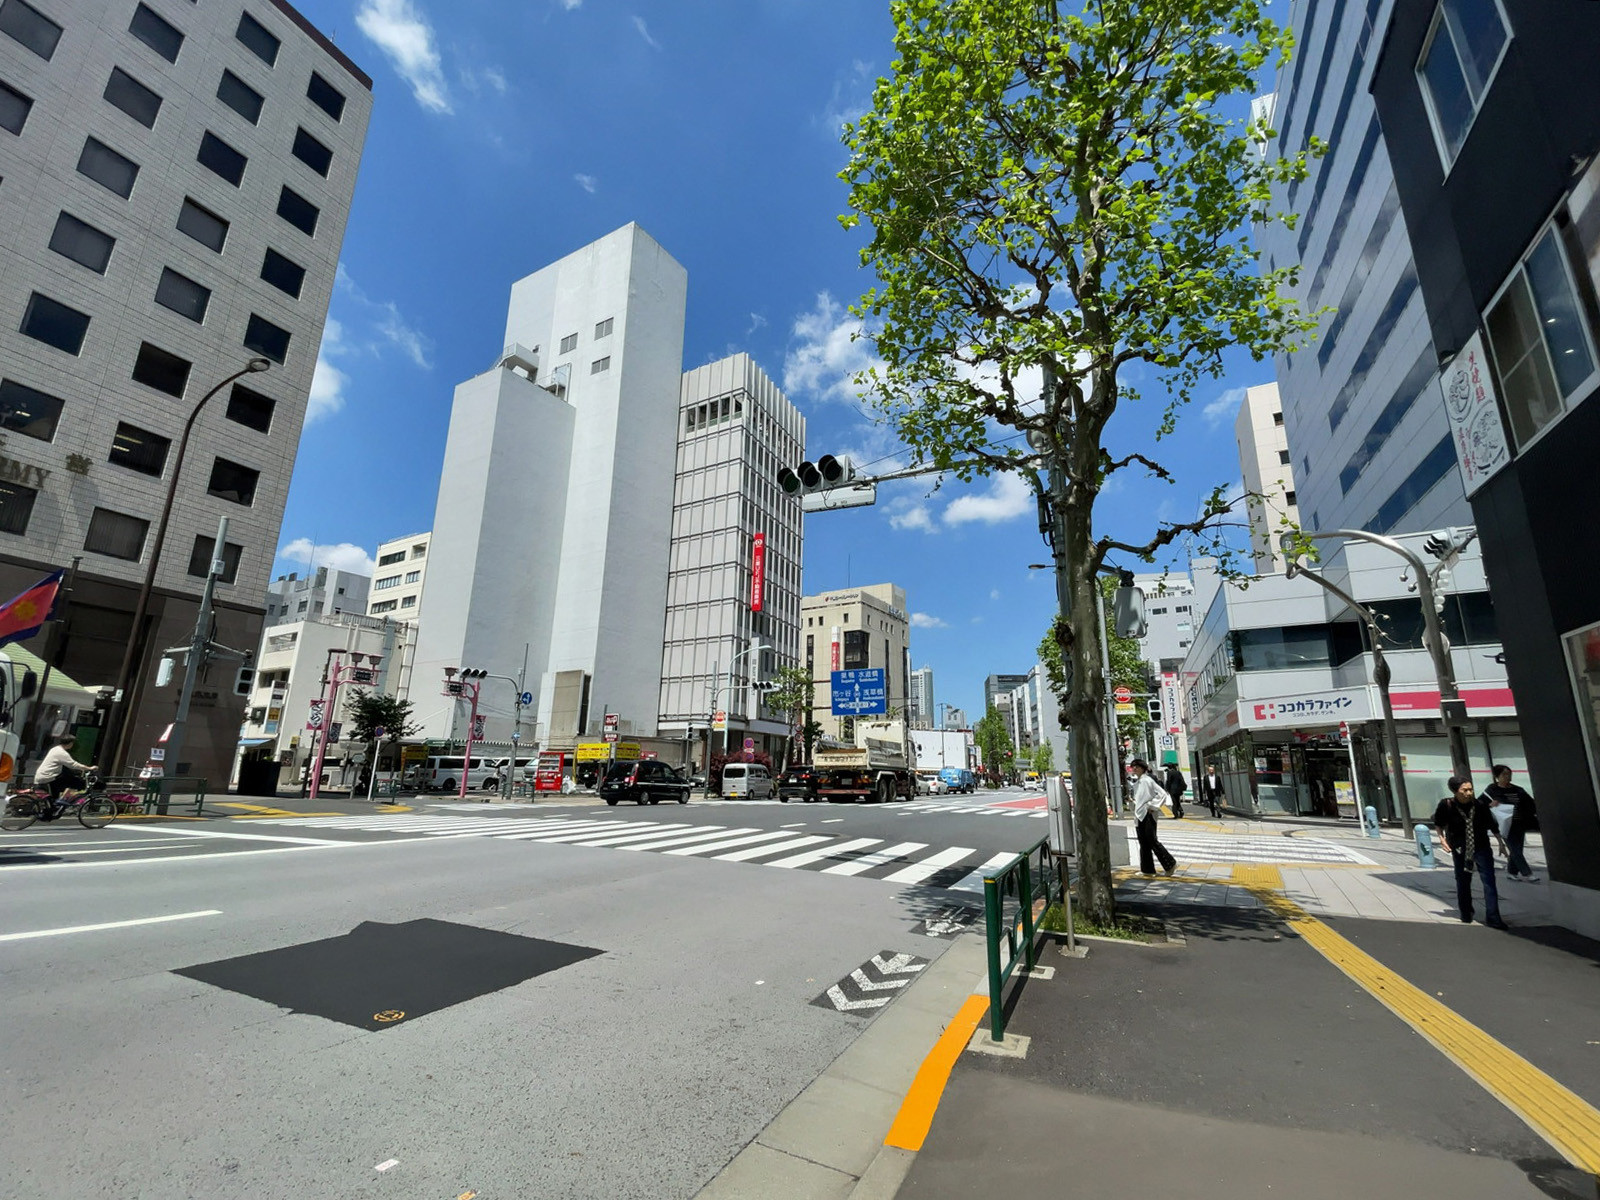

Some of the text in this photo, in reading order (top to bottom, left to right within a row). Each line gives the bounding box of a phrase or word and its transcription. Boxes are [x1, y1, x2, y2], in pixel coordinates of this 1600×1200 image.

[863, 688, 883, 696] 浅草橋
[1168, 687, 1177, 725] ココカラファイン
[1278, 697, 1352, 713] ココカラファイン
